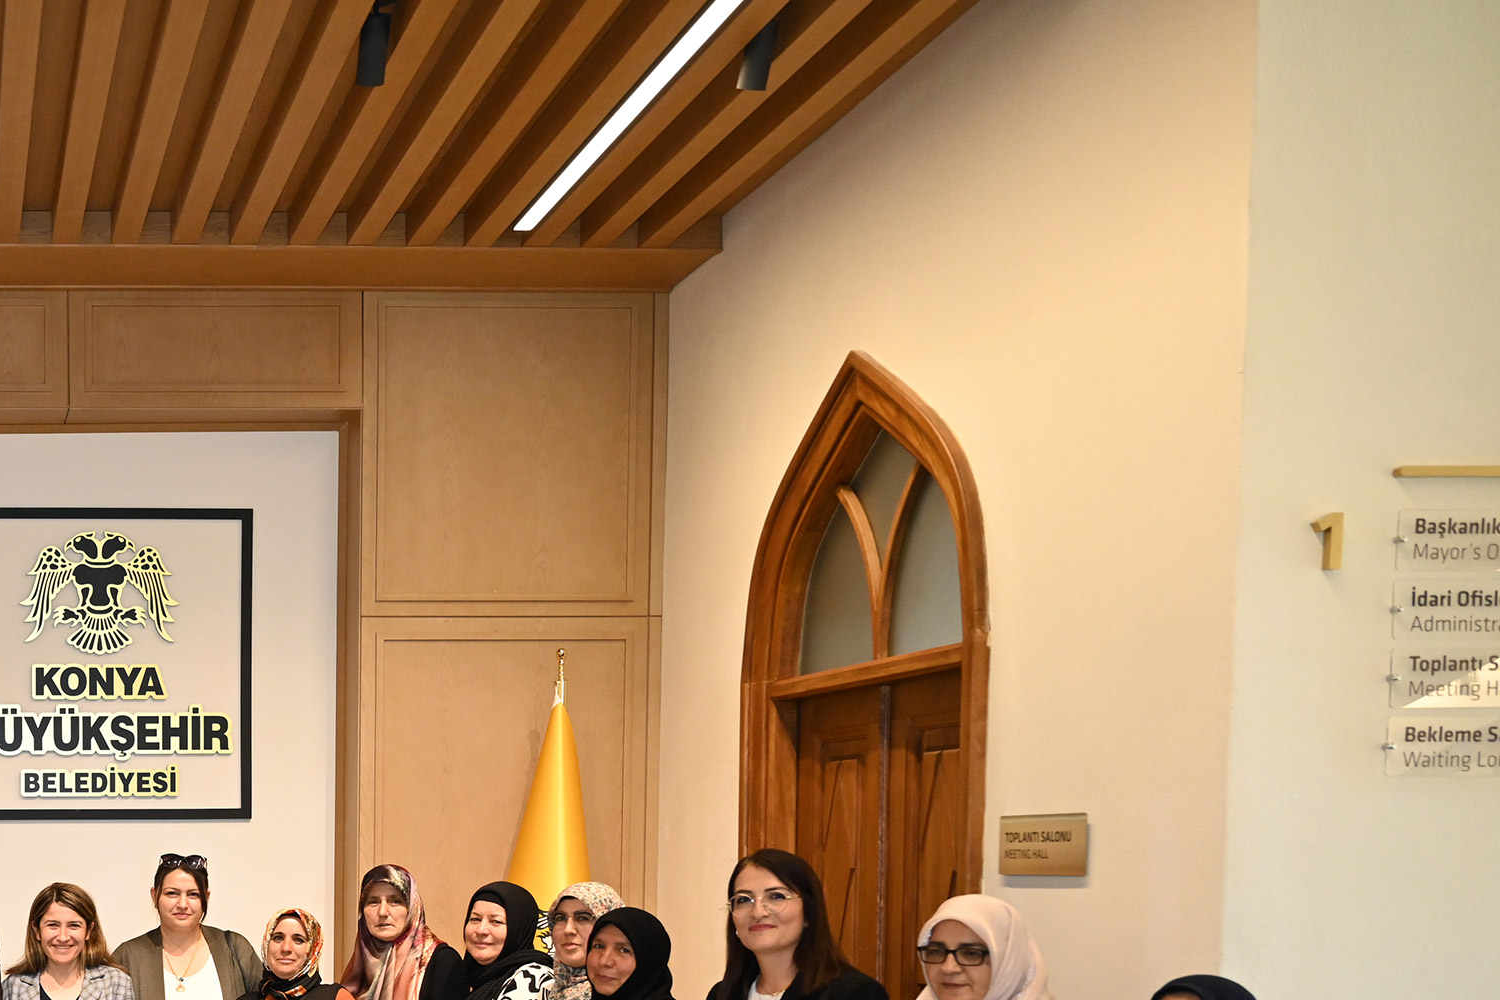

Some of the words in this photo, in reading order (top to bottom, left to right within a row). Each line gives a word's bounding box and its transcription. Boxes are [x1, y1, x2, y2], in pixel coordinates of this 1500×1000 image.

[1310, 512, 1344, 571] 1
[1413, 543, 1481, 564] Mayor's
[1411, 586, 1452, 607] İdari
[1457, 590, 1500, 607] Ofisl
[1410, 615, 1500, 632] Administr
[1409, 655, 1482, 676] Toplantı
[35, 666, 164, 697] KONYA
[1408, 680, 1480, 701] Meeting
[1404, 726, 1482, 742] Bekleme
[1488, 726, 1500, 742] S
[1403, 751, 1471, 772] Waiting
[1477, 751, 1500, 768] Lo
[24, 766, 177, 793] BELEDİYESİ
[1041, 831, 1072, 843] SALONU
